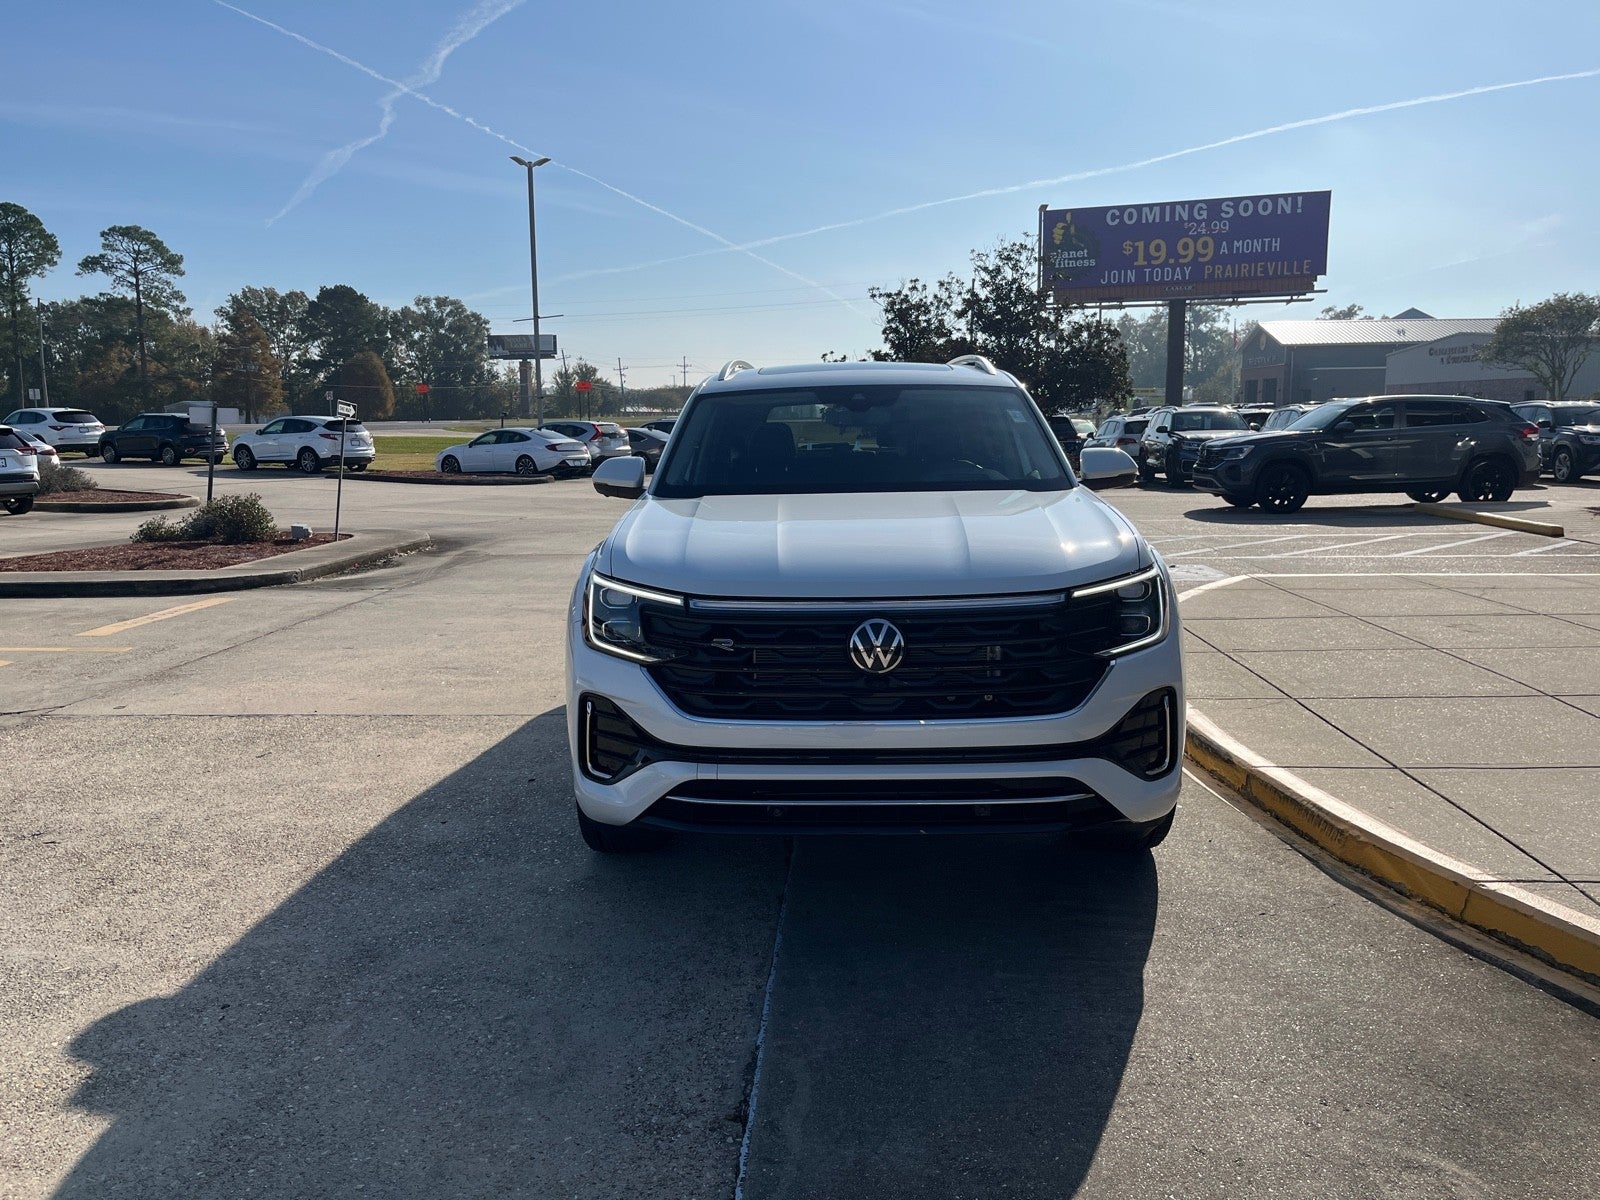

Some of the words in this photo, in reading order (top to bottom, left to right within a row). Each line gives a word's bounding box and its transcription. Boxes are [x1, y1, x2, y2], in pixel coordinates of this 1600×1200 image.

[1105, 203, 1208, 226] COMING
[1220, 196, 1303, 218] SOON!
[1184, 220, 1230, 235] $24.99
[1055, 258, 1096, 268] fitness
[1122, 236, 1215, 266] $19.99
[1220, 241, 1228, 255] A
[1233, 238, 1280, 254] MONTH
[1100, 269, 1136, 284] JOIN
[1144, 266, 1192, 282] TODAY
[1204, 260, 1312, 279] PRAIRIEVILLE
